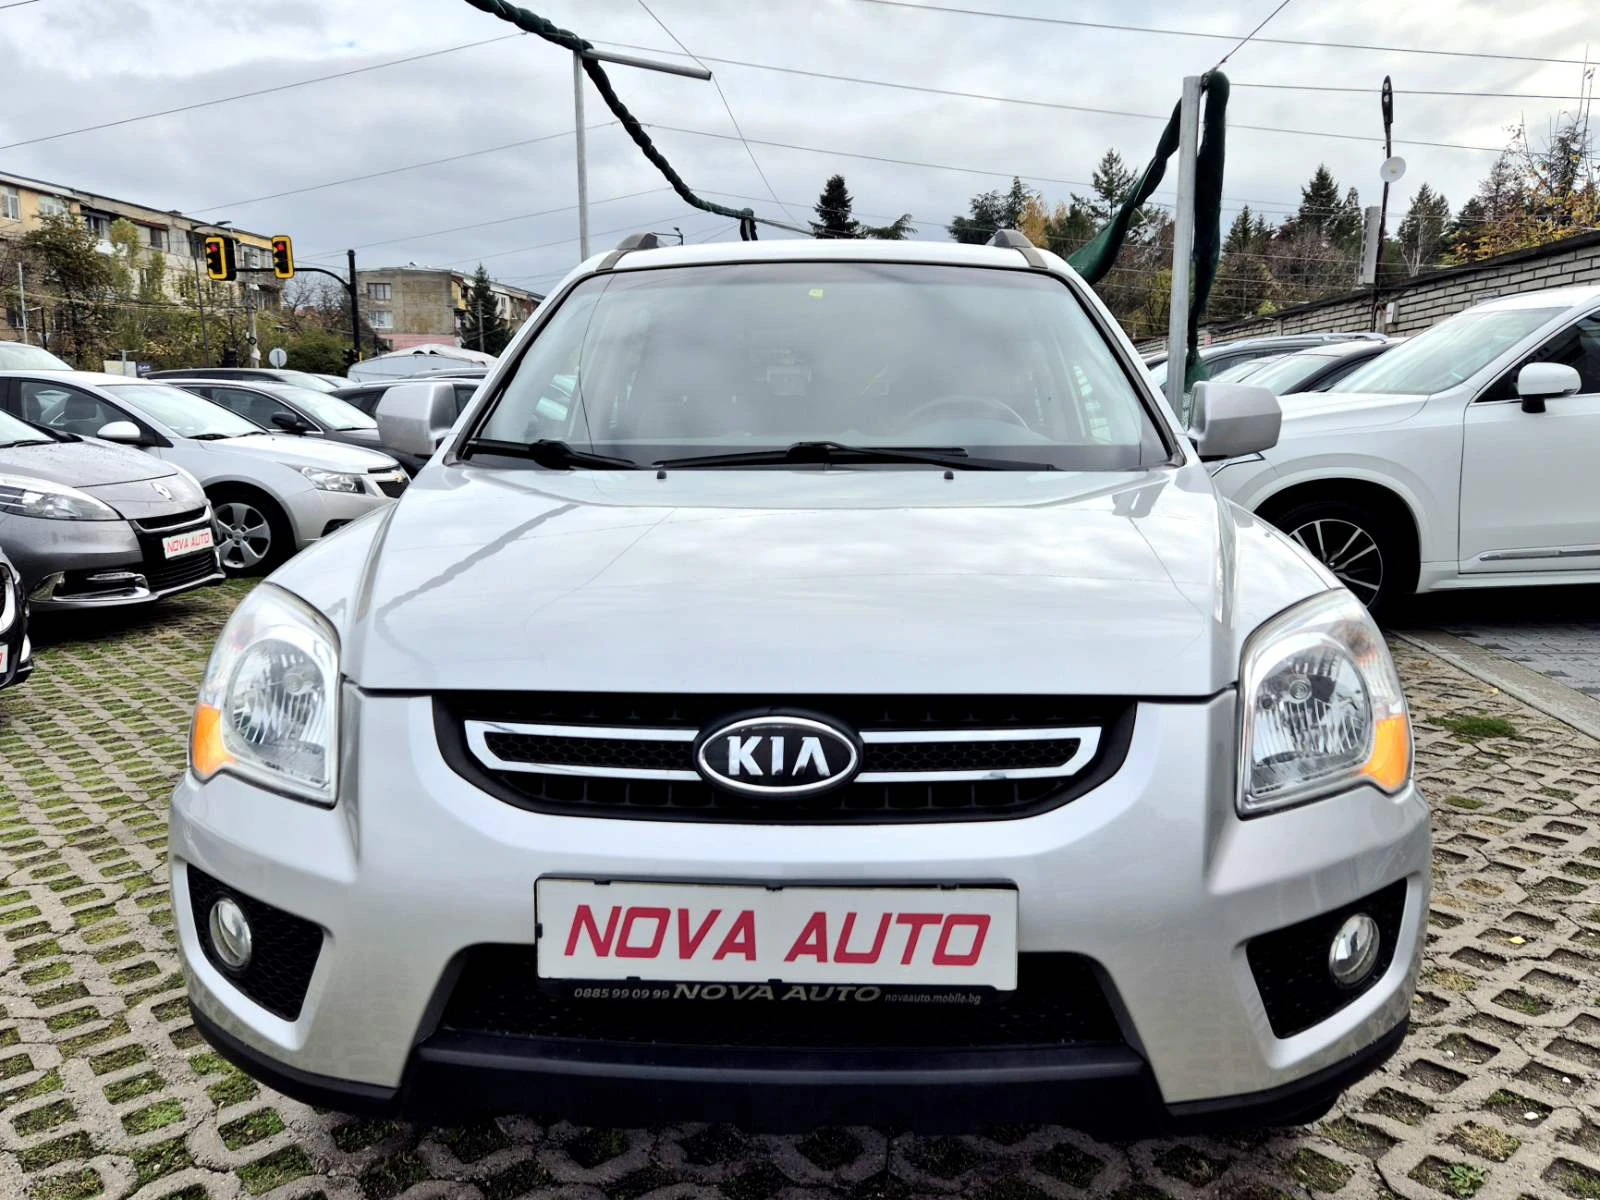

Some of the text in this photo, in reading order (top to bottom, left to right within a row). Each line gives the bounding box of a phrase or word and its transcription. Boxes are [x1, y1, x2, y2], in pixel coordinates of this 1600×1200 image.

[167, 532, 209, 553] NOVA AUTO
[727, 736, 831, 776] KIA
[564, 904, 991, 966] NOVA AUTO
[574, 984, 981, 1005] 0885 99 09 99 NOVA AUTO novaauto.mobile.bg
